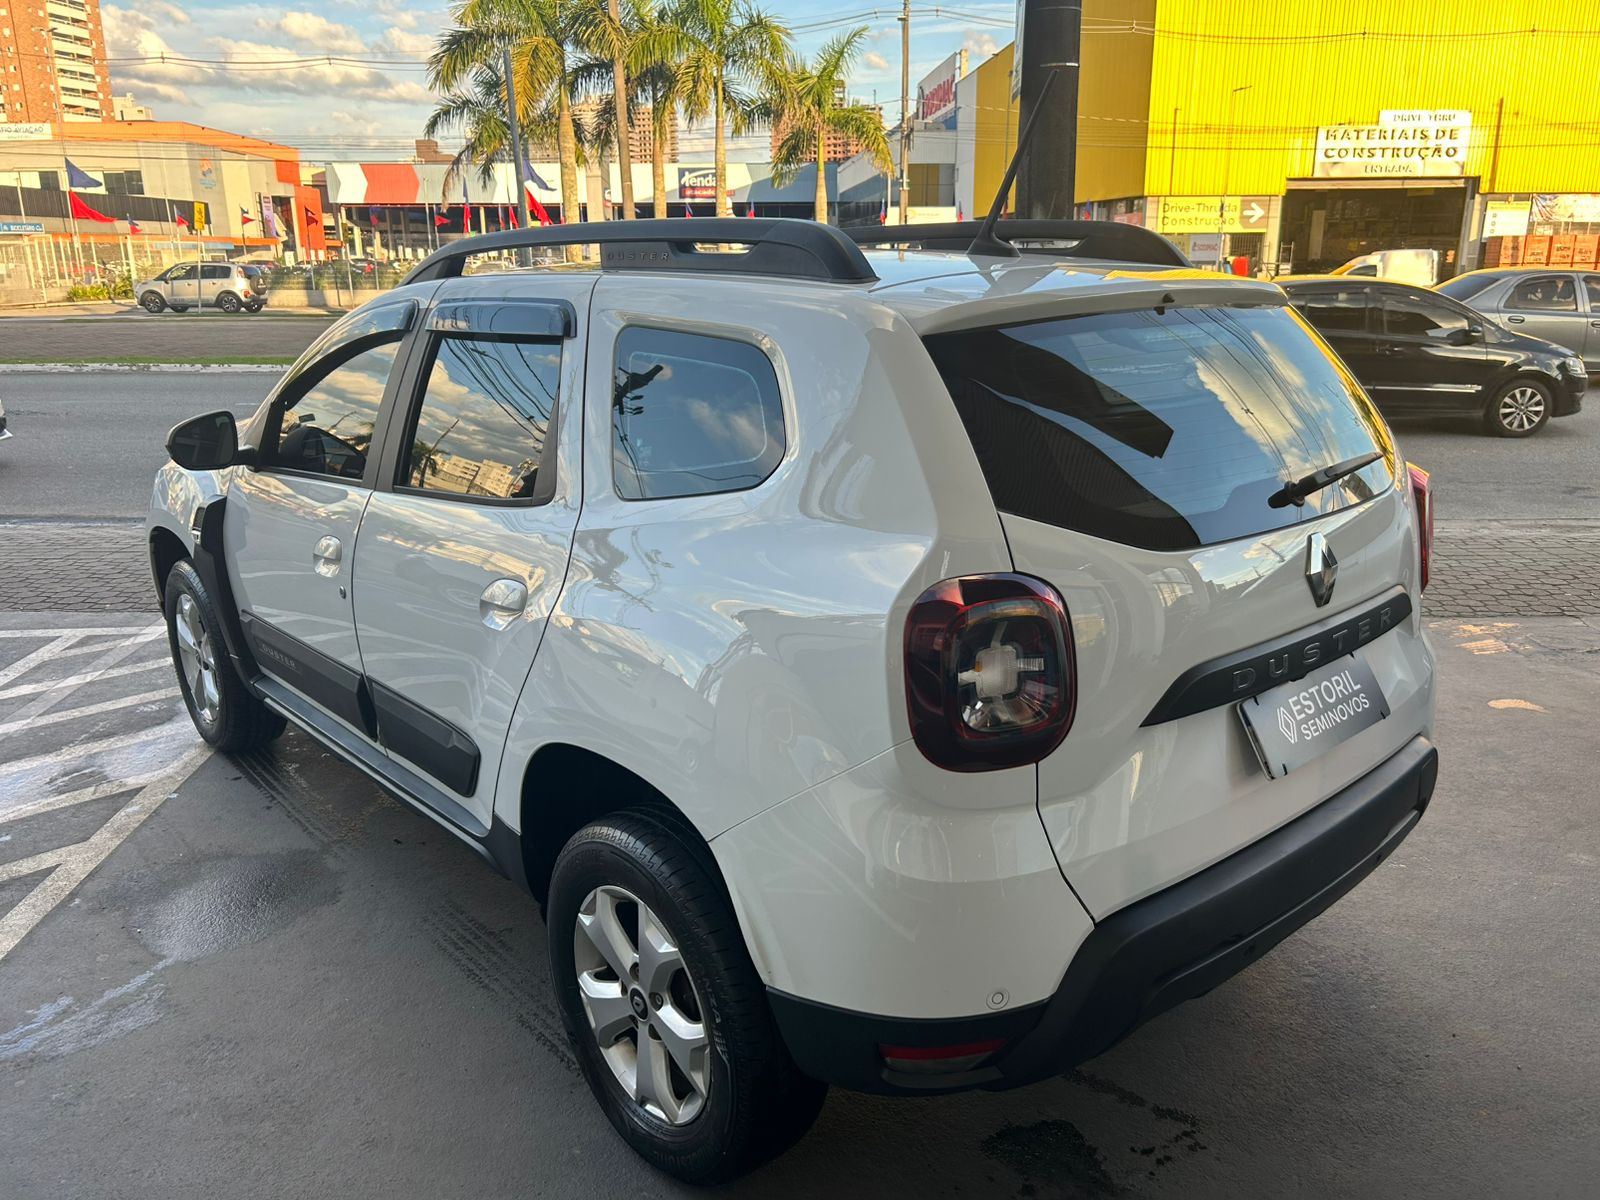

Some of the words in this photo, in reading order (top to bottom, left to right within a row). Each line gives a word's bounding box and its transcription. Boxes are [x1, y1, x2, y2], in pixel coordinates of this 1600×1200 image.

[1325, 128, 1429, 141] MATERIAIS
[1435, 128, 1459, 140] DE
[1323, 144, 1458, 160] CONSTRUÇÃO
[1162, 202, 1220, 213] Drive-Thru
[1225, 202, 1237, 213] da
[607, 250, 670, 262] DUSTER
[1232, 607, 1392, 692] DUSTER
[1288, 670, 1362, 721] ESTORIL
[1300, 693, 1370, 741] SEMINOVOS
